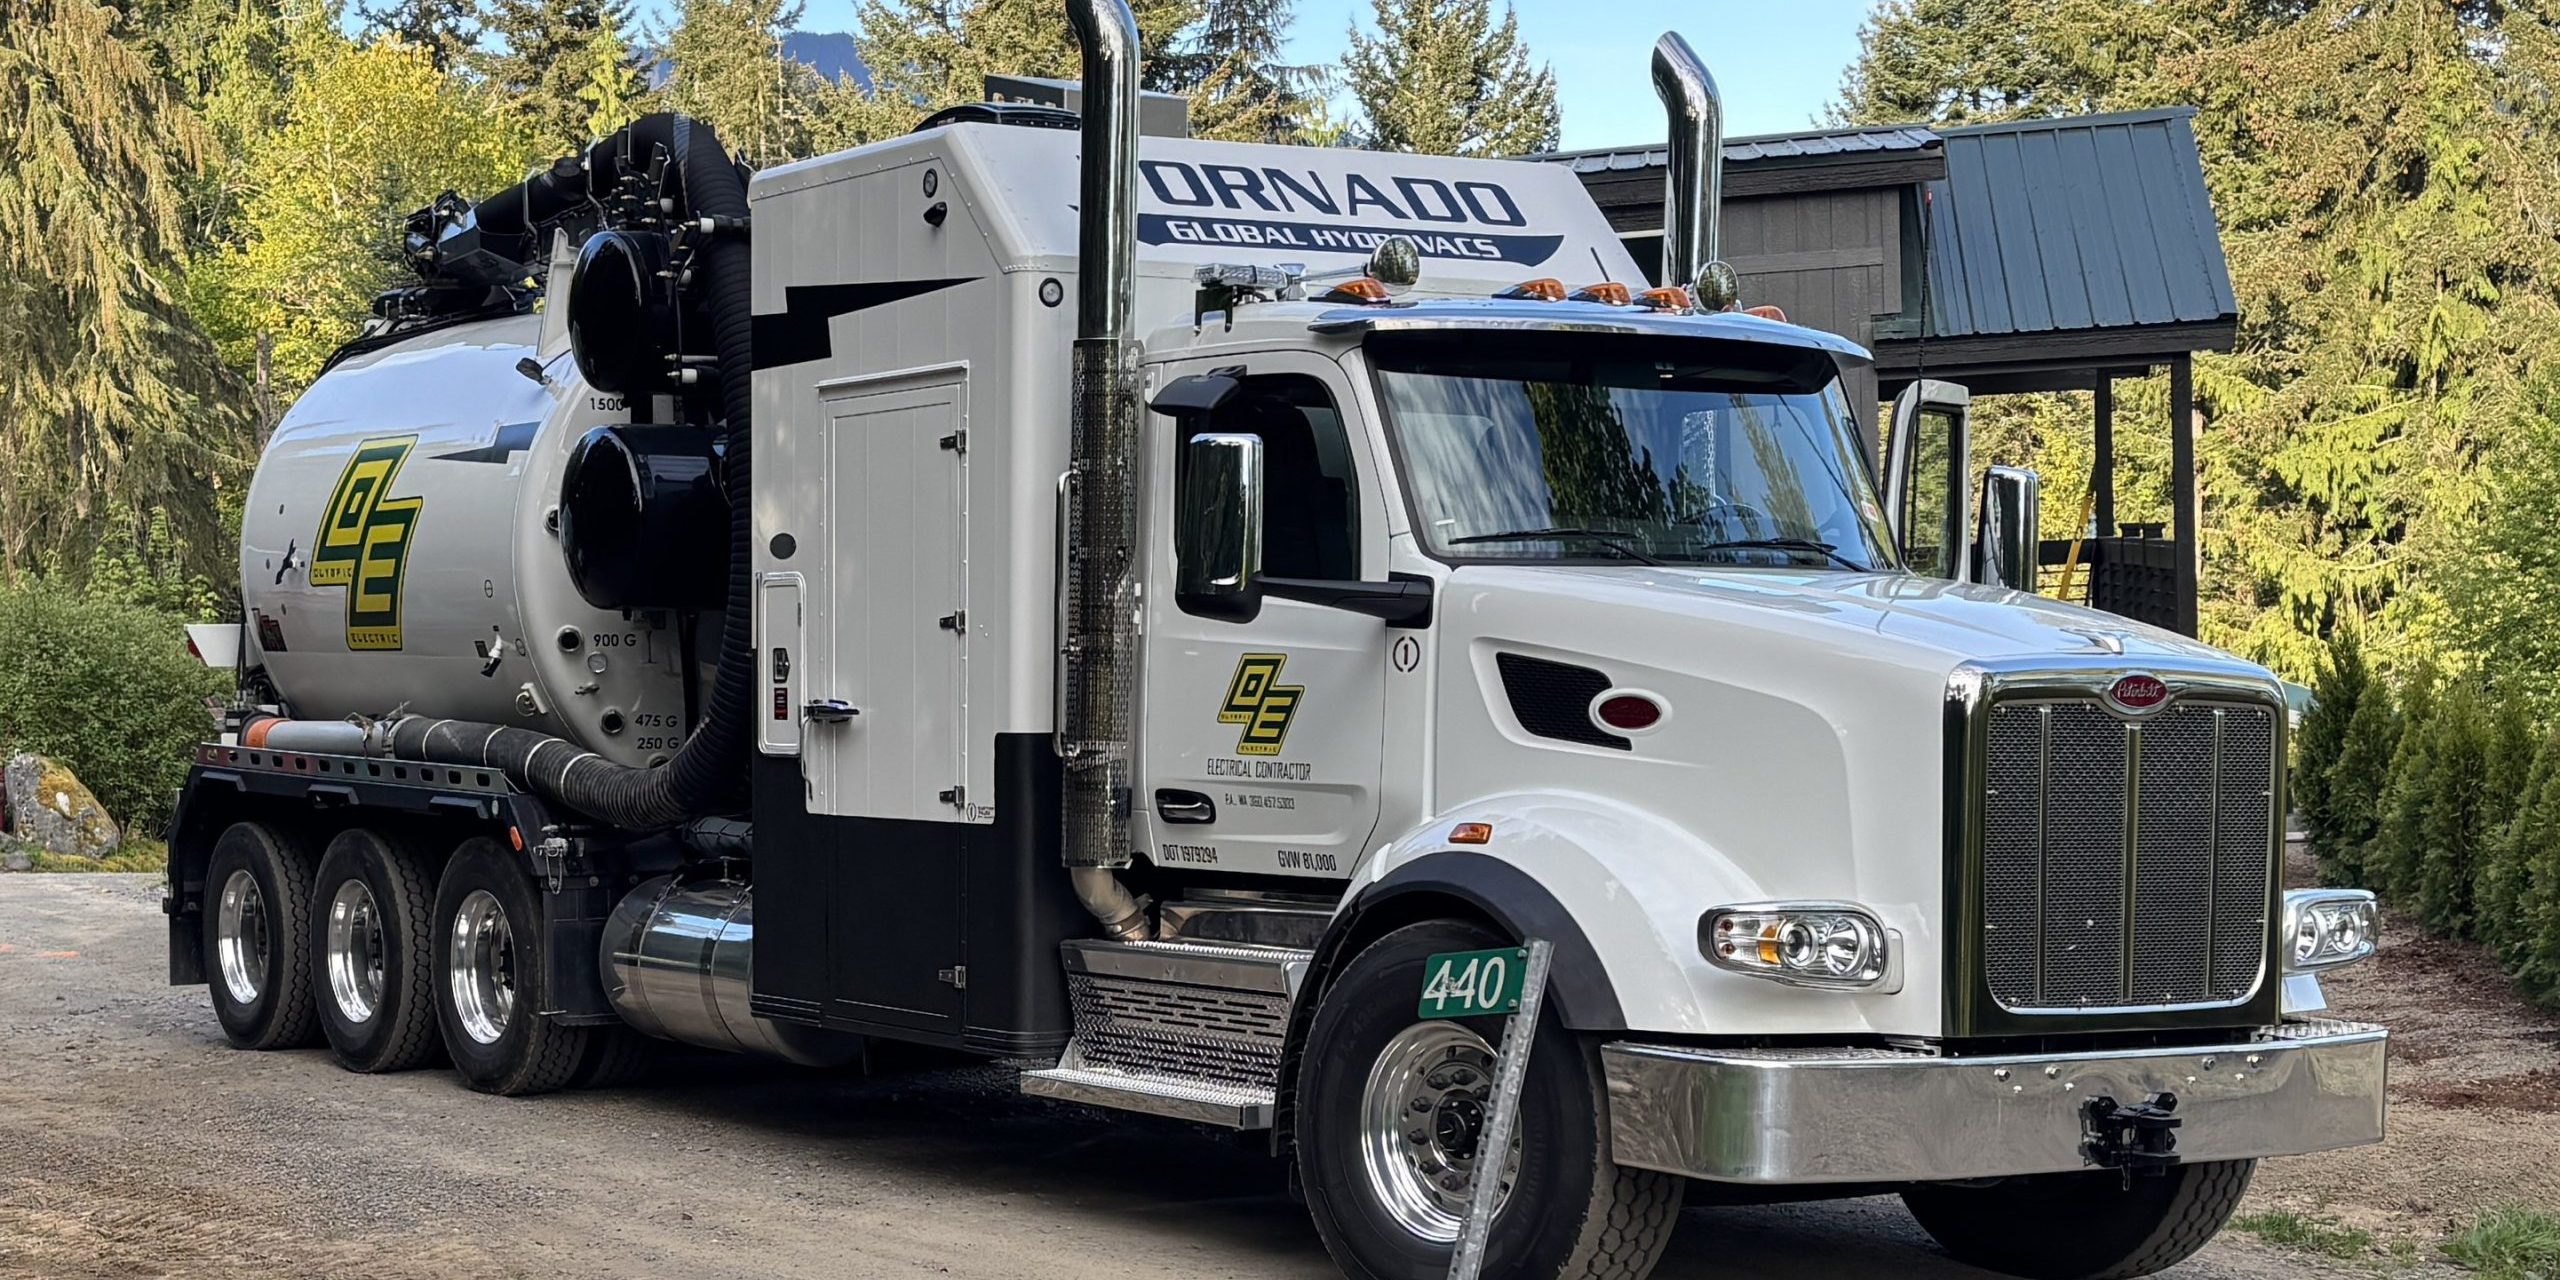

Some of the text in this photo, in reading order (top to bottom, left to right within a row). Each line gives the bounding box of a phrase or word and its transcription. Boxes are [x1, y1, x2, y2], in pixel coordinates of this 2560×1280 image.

[1138, 159, 1527, 228] ORNADO
[1166, 220, 1308, 246] GLOBAL
[351, 632, 399, 644] ELECTRIC
[593, 633, 637, 647] 900 G
[635, 714, 678, 728] 475 G
[637, 736, 679, 750] 250 G
[1207, 758, 1311, 781] ELECTRICAL CONTRACTOR
[1162, 844, 1218, 864] DOT 1979294
[1278, 850, 1337, 872] GVW 81,000
[1422, 956, 1506, 1010] 440
